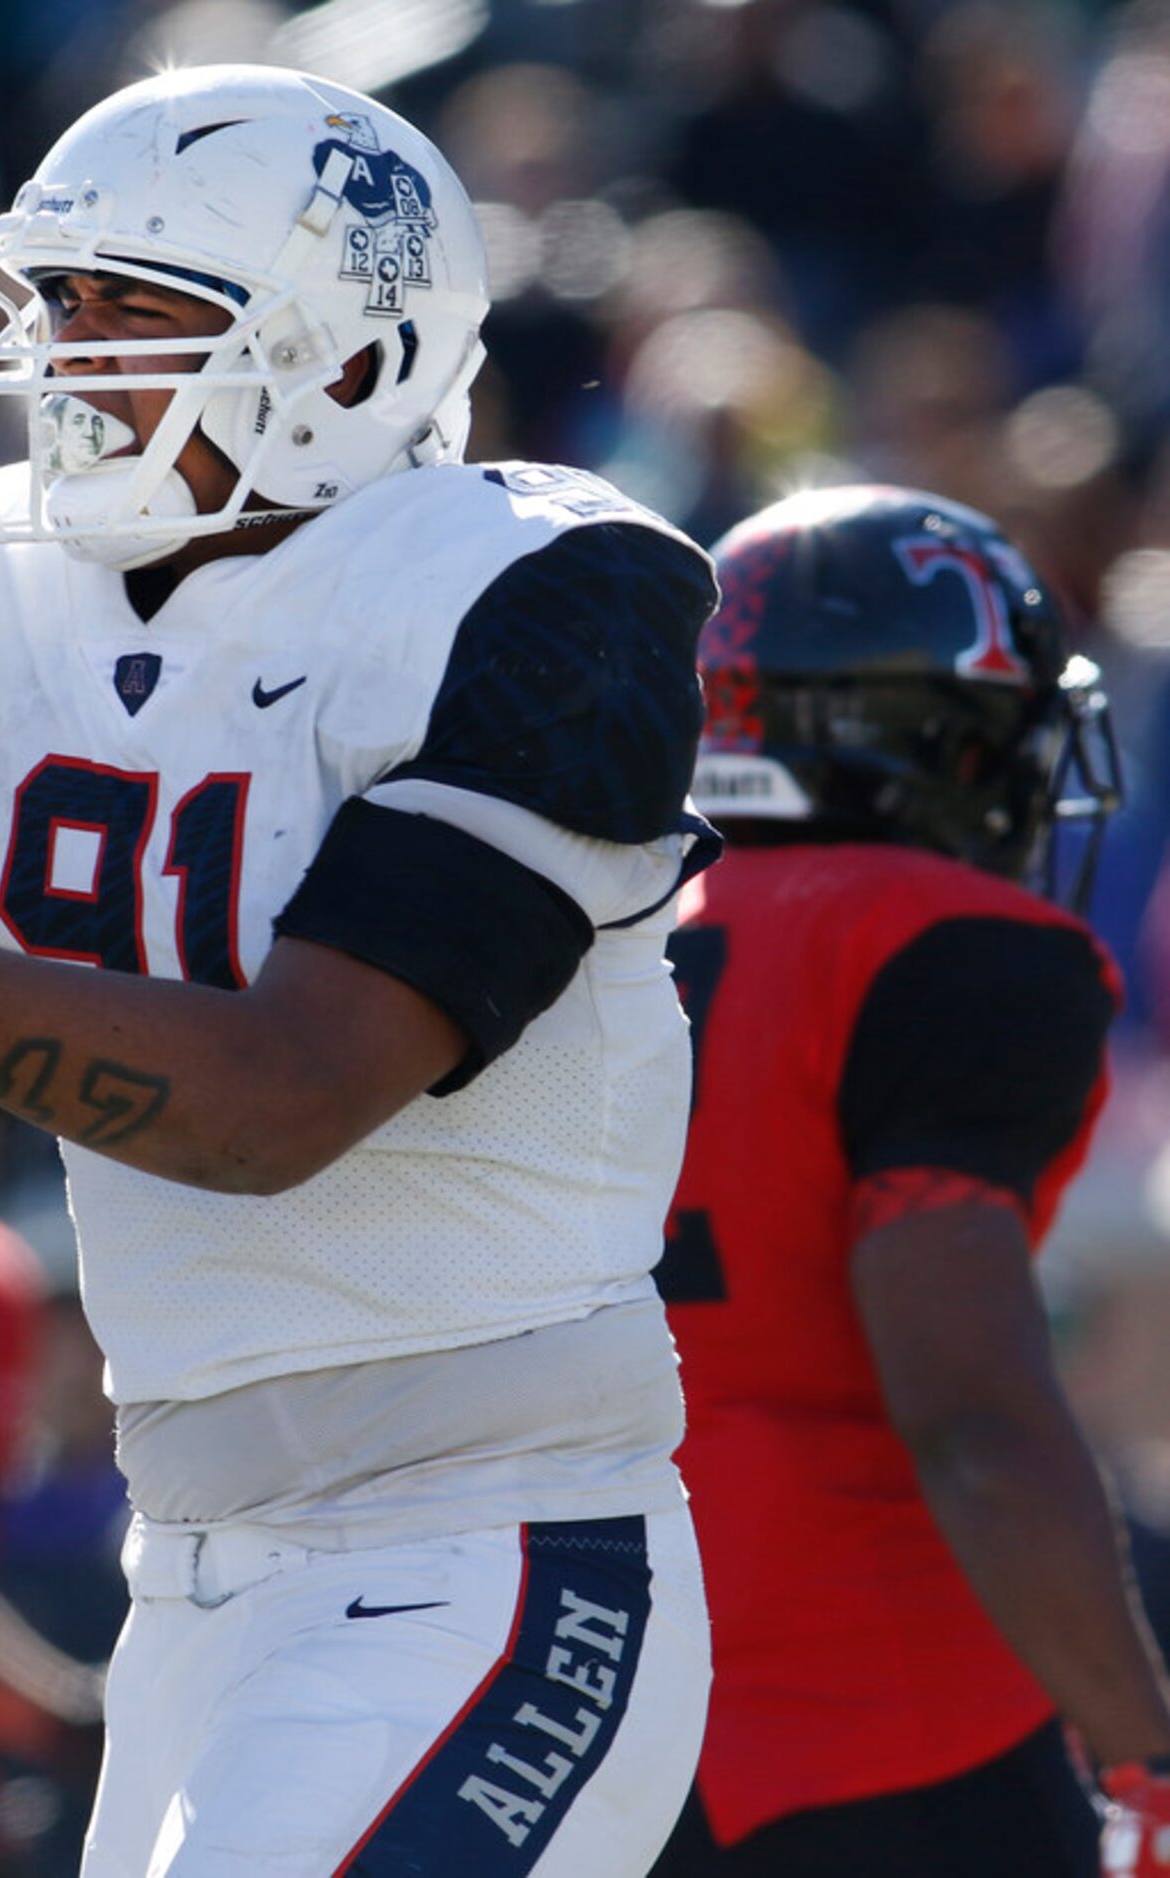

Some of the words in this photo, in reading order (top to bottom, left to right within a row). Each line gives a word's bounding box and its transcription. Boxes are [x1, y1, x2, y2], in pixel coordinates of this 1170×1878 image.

[351, 155, 375, 186] A
[351, 253, 369, 272] 12
[408, 260, 424, 278] 13
[377, 285, 397, 307] 14
[457, 1588, 629, 1848] ALLEN
